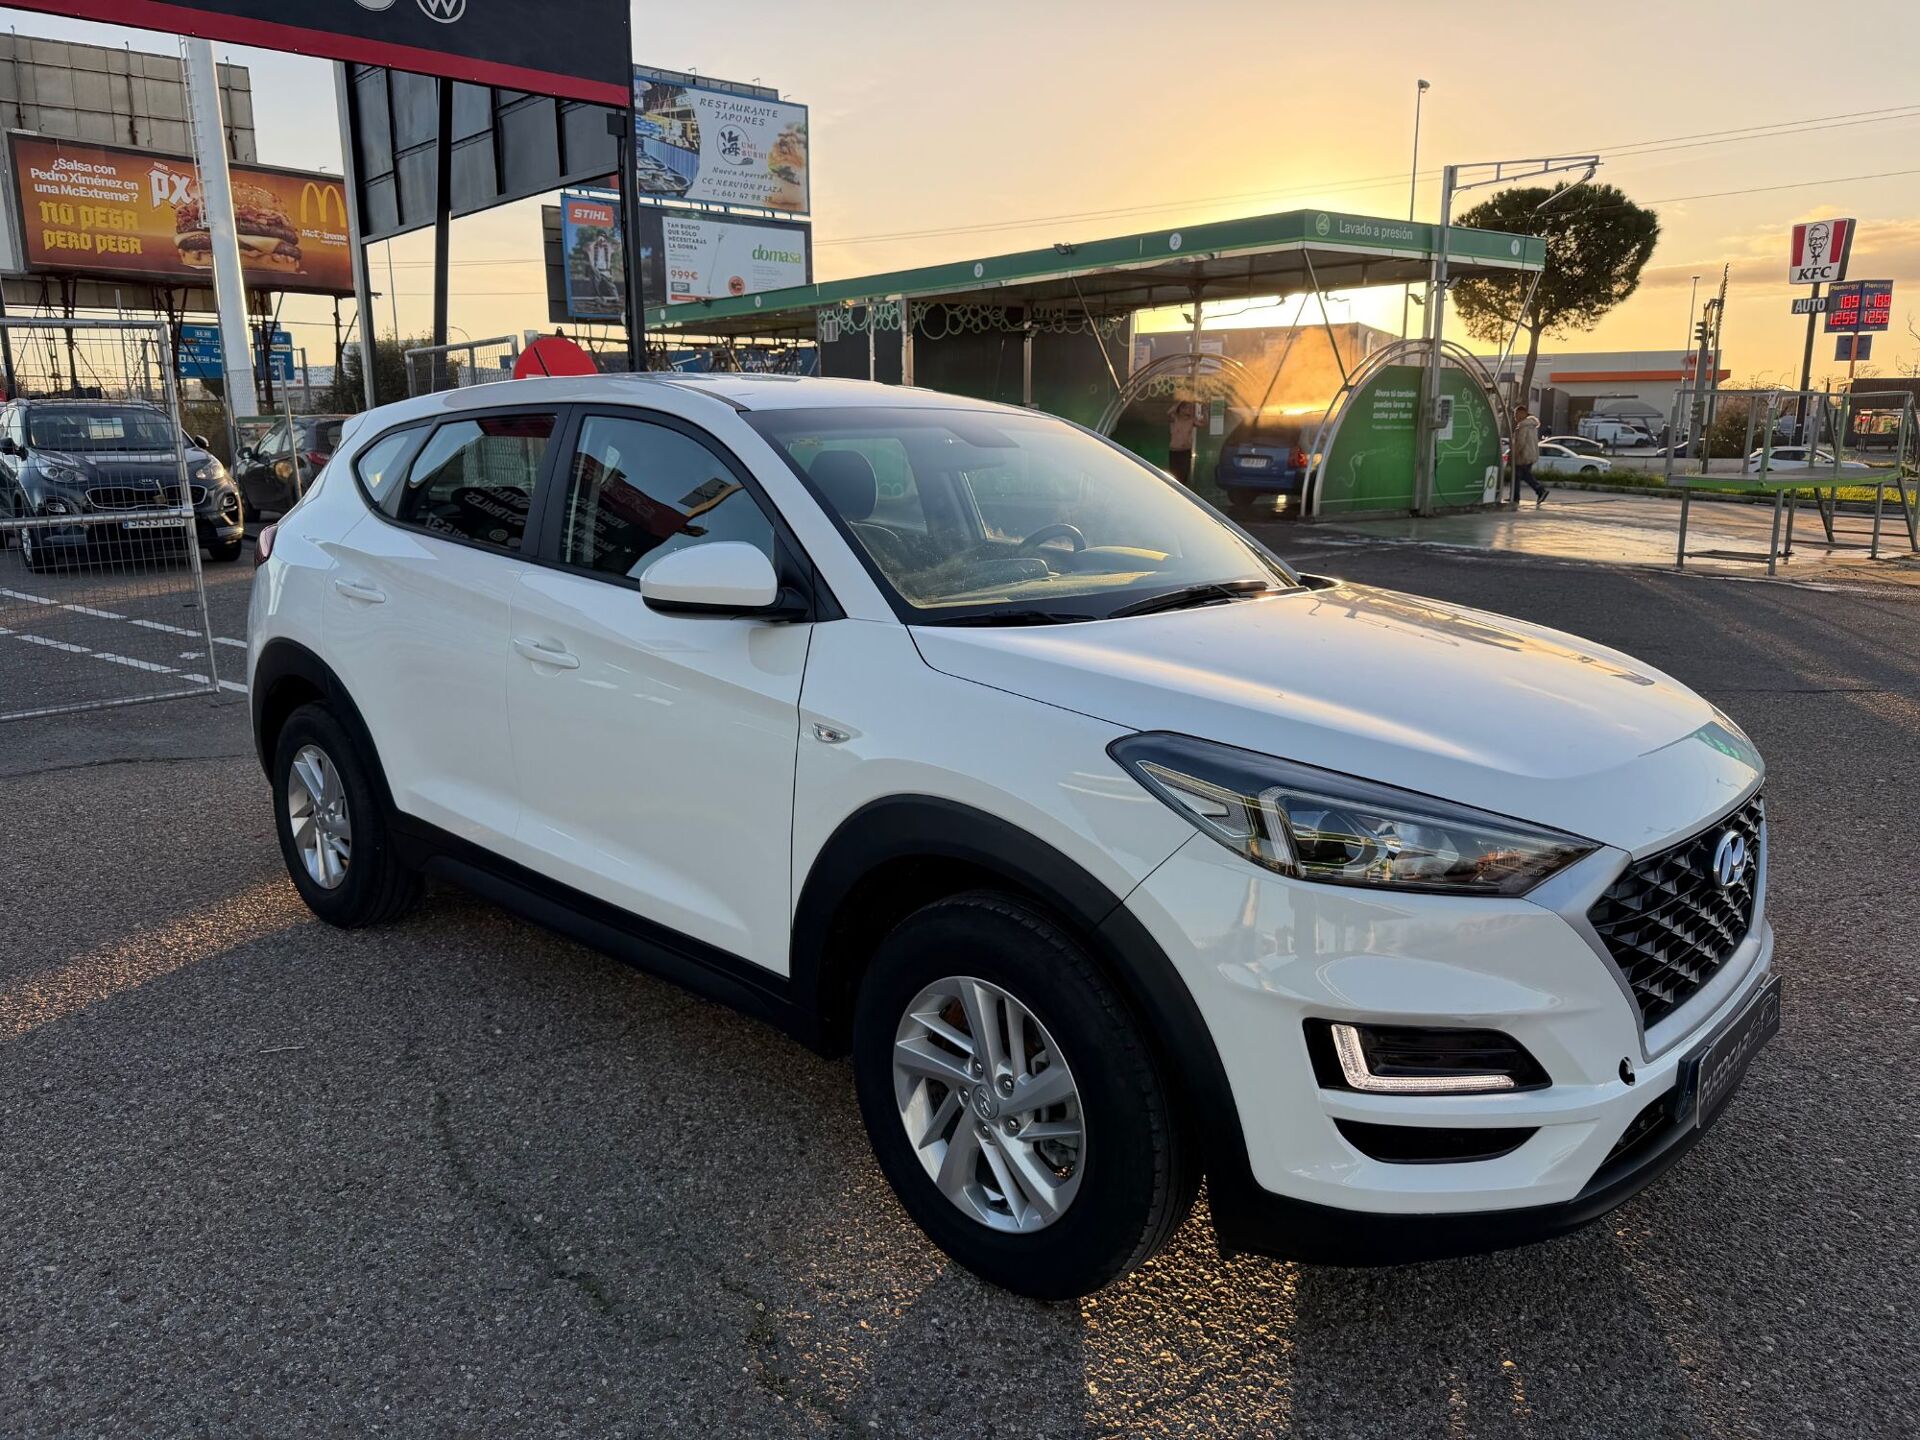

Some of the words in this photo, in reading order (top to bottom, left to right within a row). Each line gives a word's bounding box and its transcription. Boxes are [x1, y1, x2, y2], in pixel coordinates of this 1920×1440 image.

[700, 98, 778, 118] RESTAURANTE
[741, 150, 767, 160] SUSHI
[51, 158, 92, 172] ¿Salsa
[93, 164, 116, 175] con
[30, 168, 68, 182] Pedro
[69, 173, 123, 188] Ximénez
[123, 180, 139, 190] en
[34, 183, 59, 195] una
[756, 184, 783, 193] PLAZA
[38, 201, 74, 226] NO
[78, 205, 140, 231] PEGA
[574, 208, 609, 221] STIHL
[1339, 220, 1372, 236] Lavado
[1373, 228, 1379, 236] a
[1381, 226, 1413, 240] presión
[42, 229, 92, 250] PERO
[95, 234, 143, 255] PEGA
[752, 244, 802, 264] domasa
[1797, 266, 1832, 281] KFC
[1794, 299, 1826, 313] AUTO
